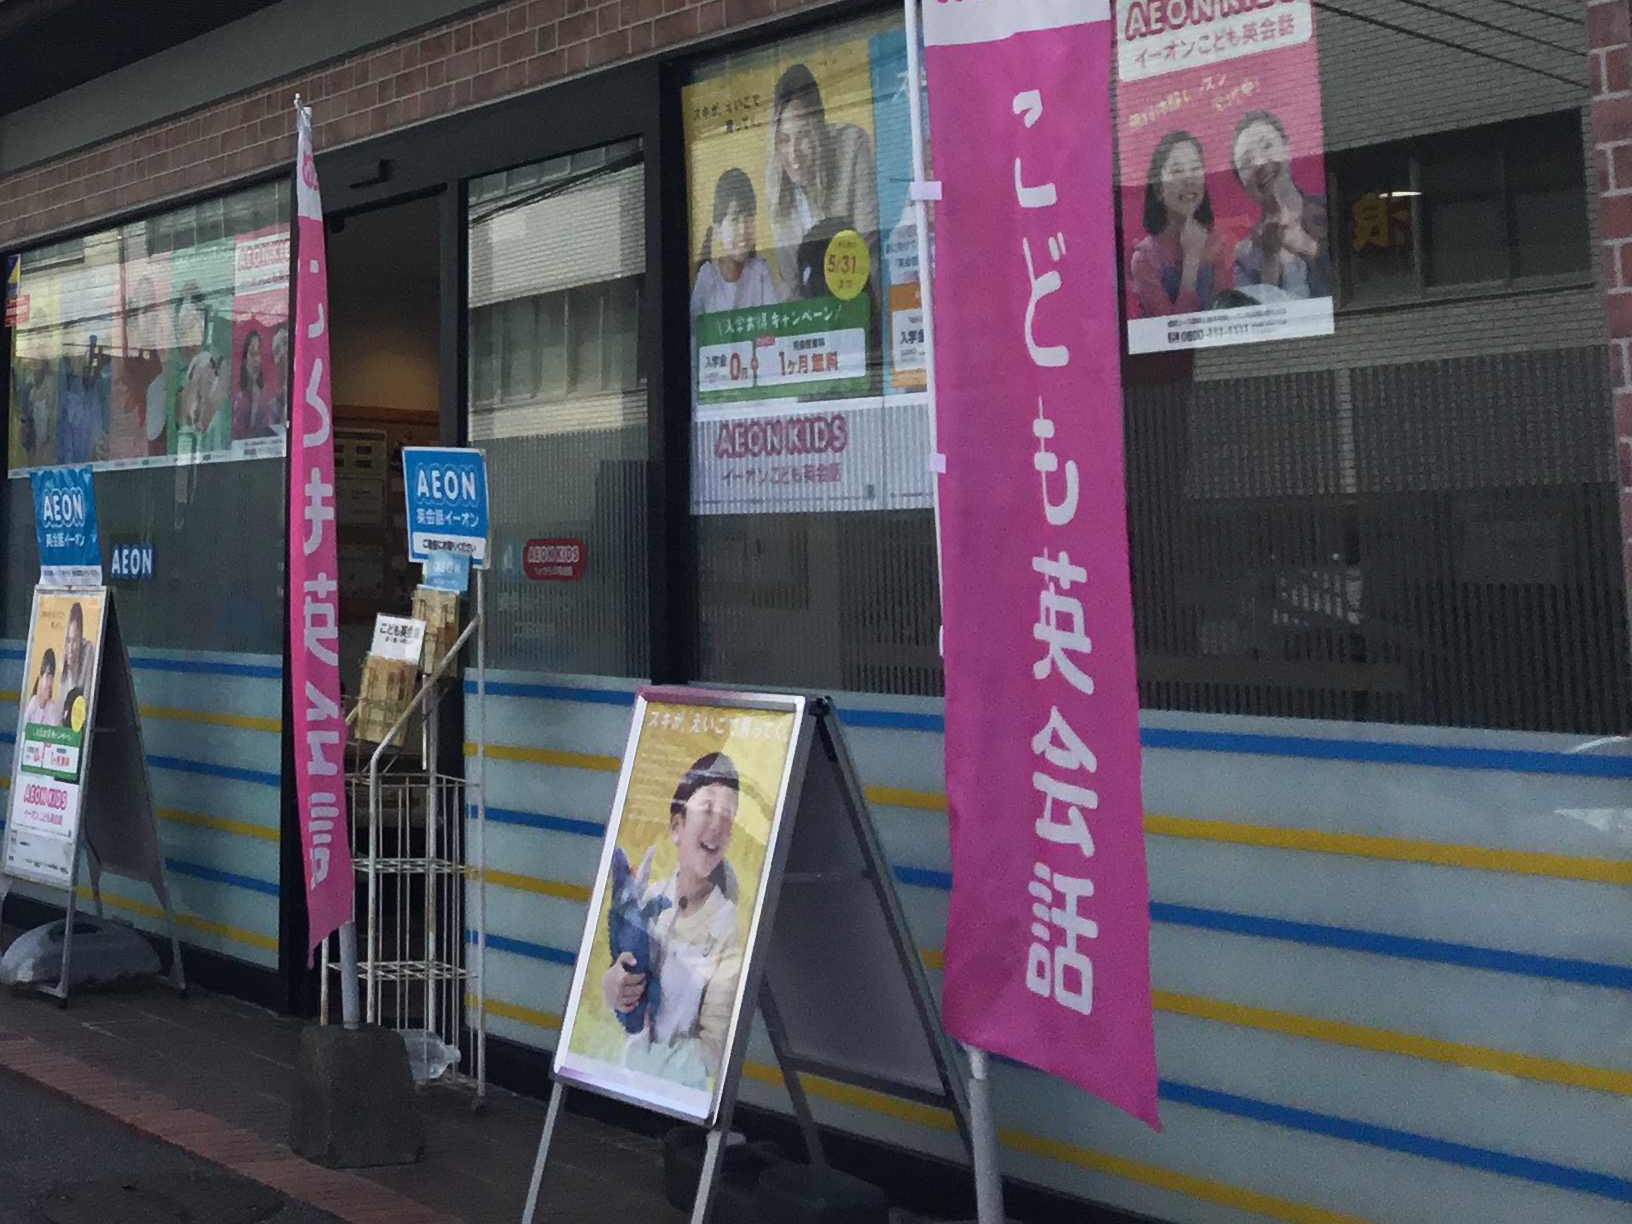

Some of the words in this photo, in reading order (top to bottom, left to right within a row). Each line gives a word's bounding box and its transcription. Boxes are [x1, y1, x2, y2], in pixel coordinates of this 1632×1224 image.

[1135, 13, 1295, 68] イーオンこども英会話
[828, 254, 857, 274] 5/31
[714, 418, 783, 459] AEON
[786, 413, 849, 456] KIDS
[416, 468, 477, 502] AEON
[722, 462, 843, 487] イーオンこども英会話
[42, 491, 85, 524] AEON
[415, 507, 480, 528] 英会話イーオン
[111, 547, 153, 576] AEON
[1012, 87, 1099, 1016] こども英会話
[23, 783, 48, 806] AEON
[47, 786, 68, 810] KIDS
